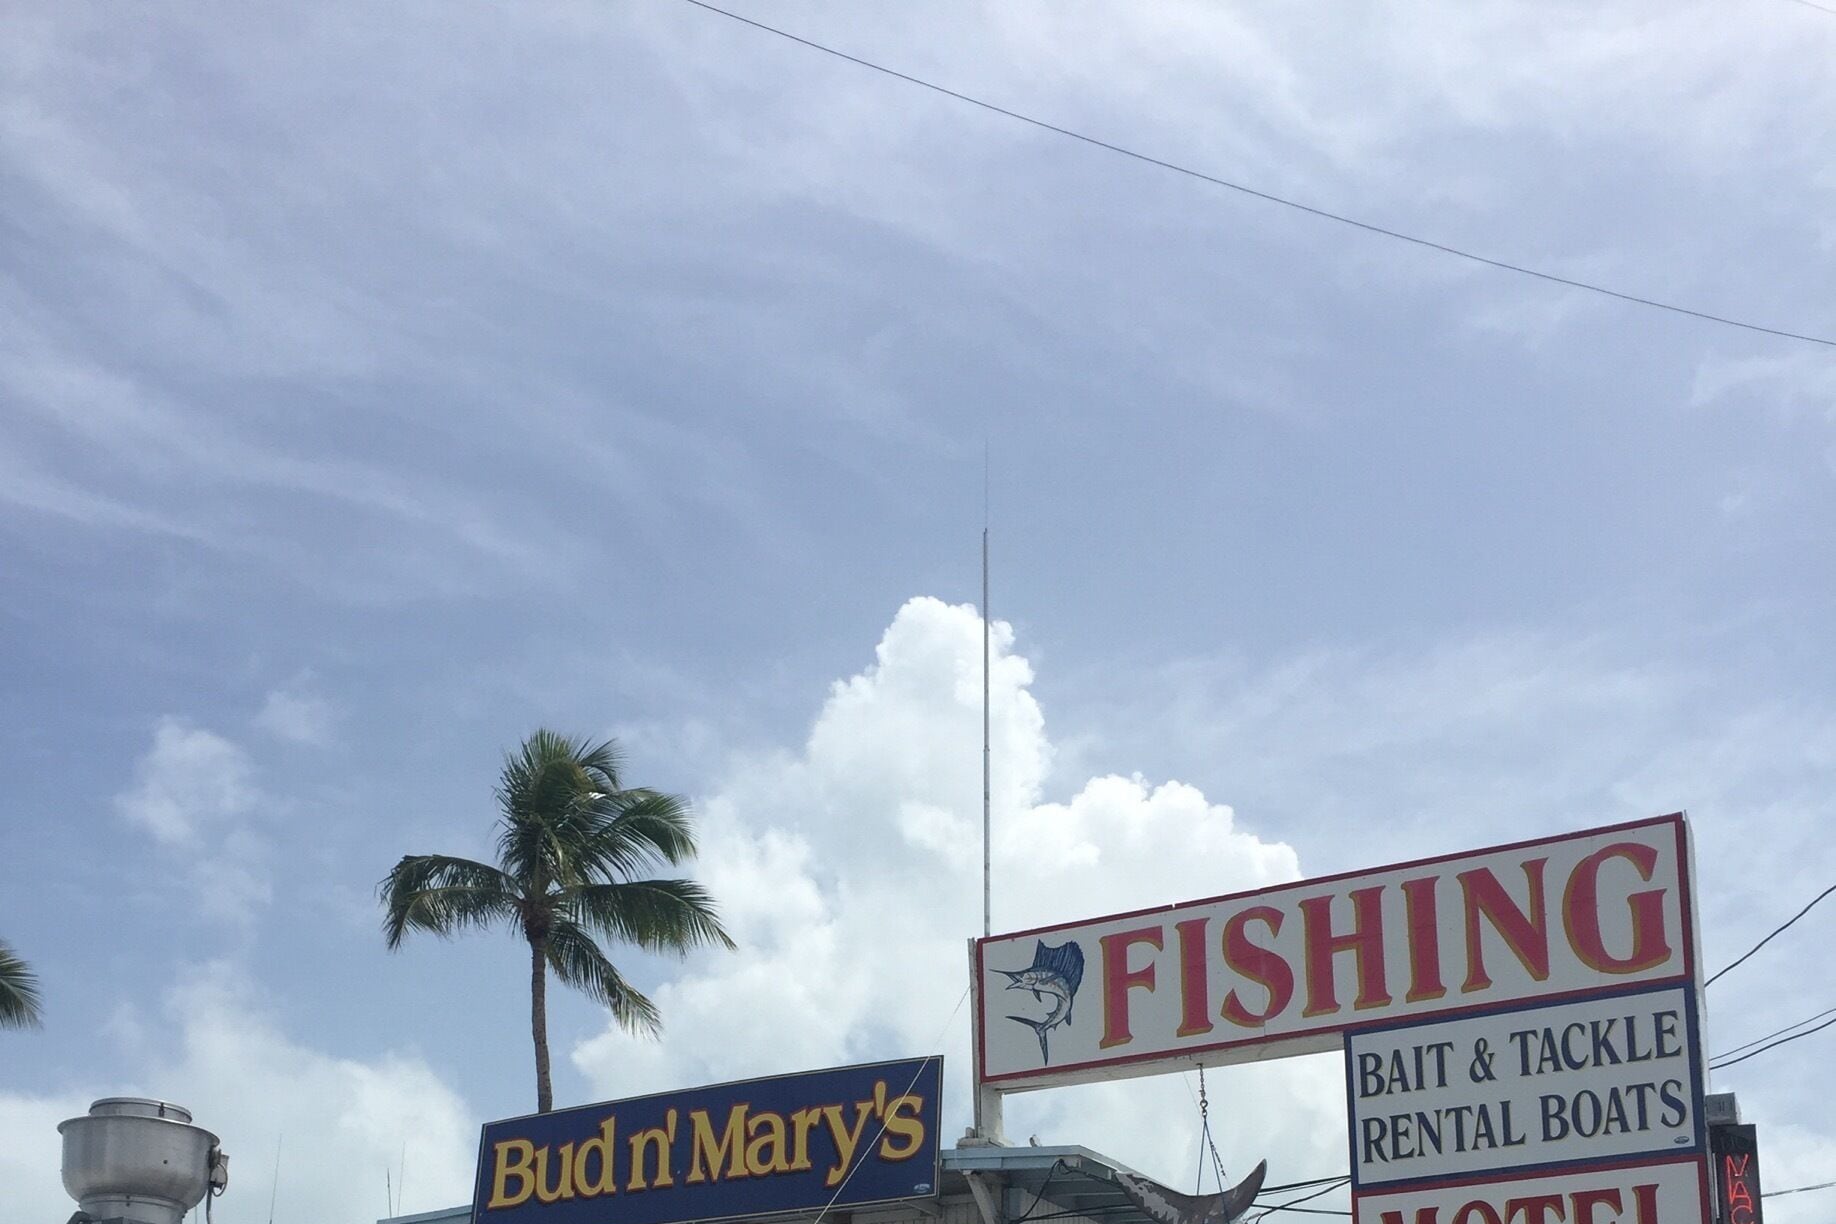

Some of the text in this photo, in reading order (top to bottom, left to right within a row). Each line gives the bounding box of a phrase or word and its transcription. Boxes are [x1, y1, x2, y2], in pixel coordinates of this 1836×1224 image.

[1099, 842, 1672, 1049] FISHING
[1358, 1010, 1682, 1098] BAIT & TACKLE
[488, 1116, 616, 1210] Bud
[685, 1080, 925, 1187] Mary's
[1361, 1079, 1687, 1164] RENTAL BOATS
